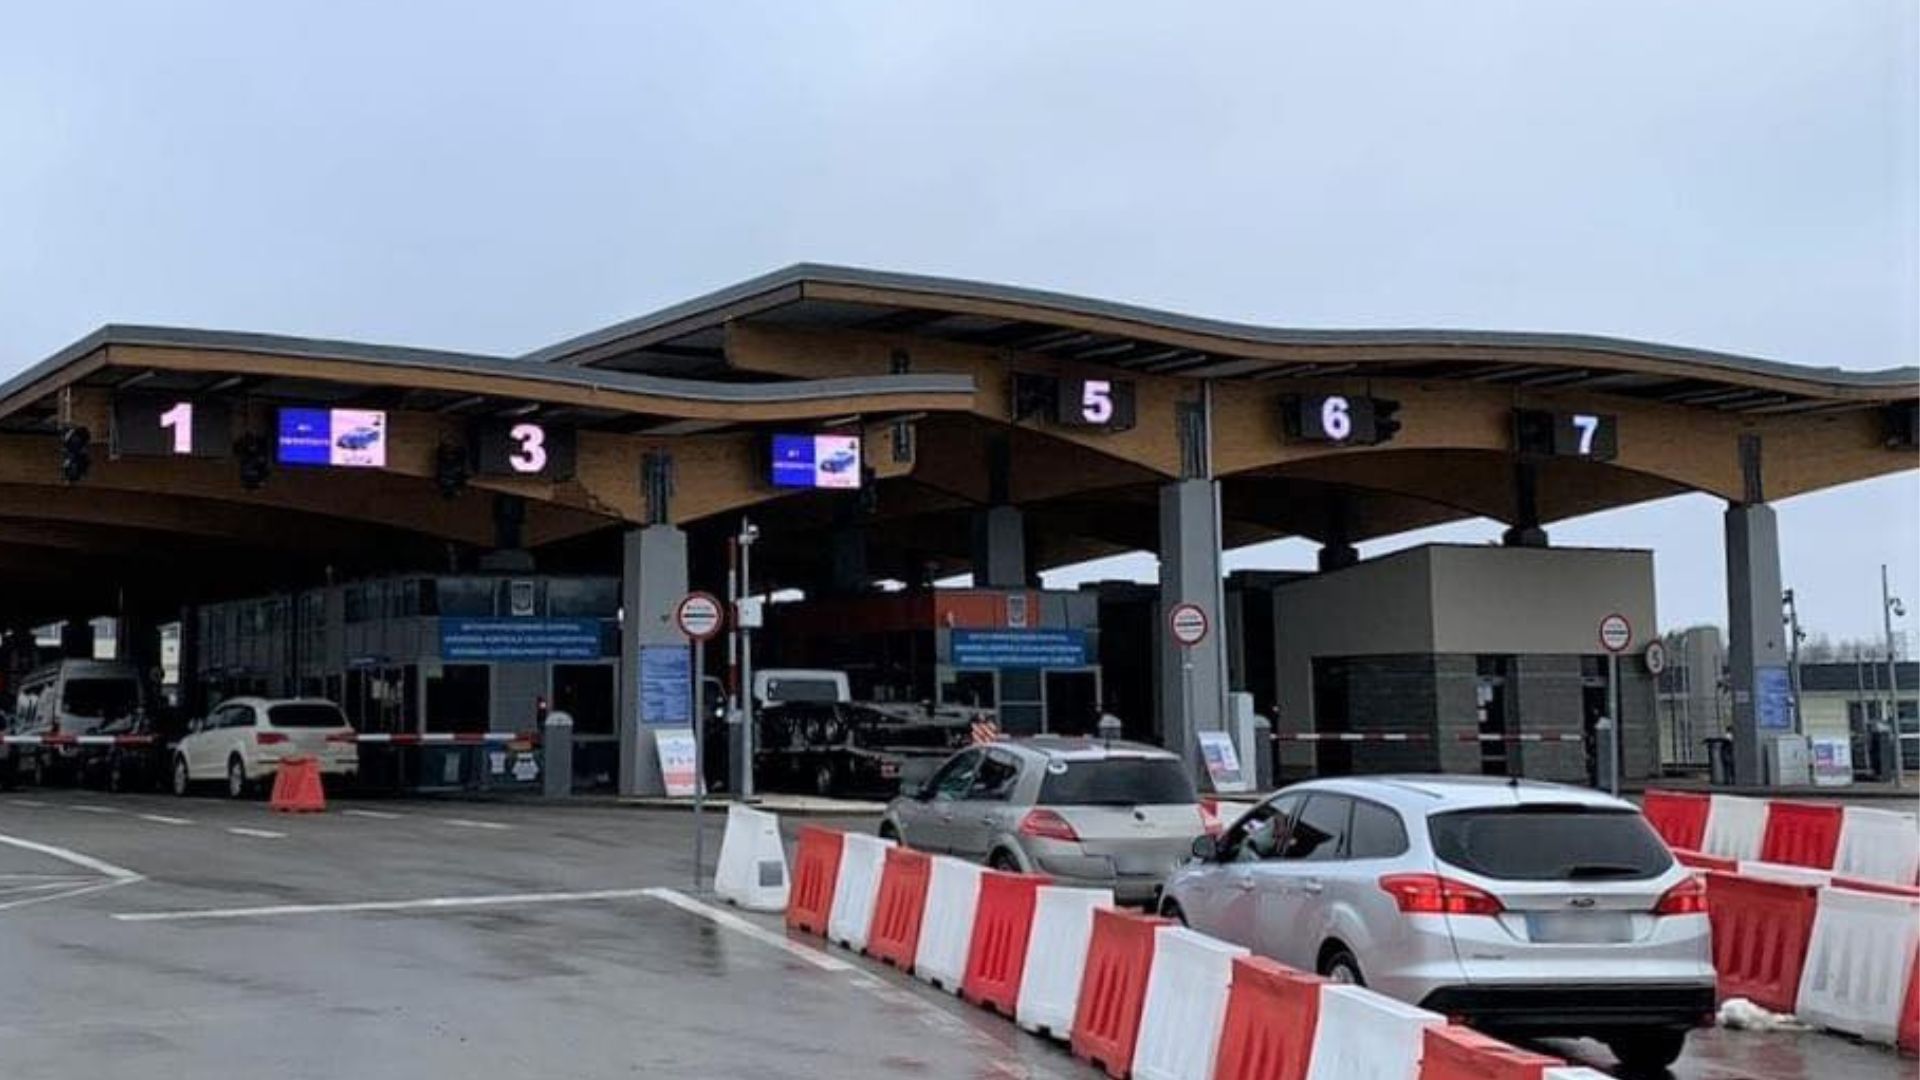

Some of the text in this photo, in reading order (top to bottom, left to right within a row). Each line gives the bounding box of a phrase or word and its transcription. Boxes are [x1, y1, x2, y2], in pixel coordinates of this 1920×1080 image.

[1083, 380, 1112, 423] 5
[1323, 397, 1350, 439] 6
[161, 403, 192, 453] 1
[510, 424, 546, 472] 3
[1573, 415, 1598, 454] 7
[1651, 650, 1661, 668] 5
